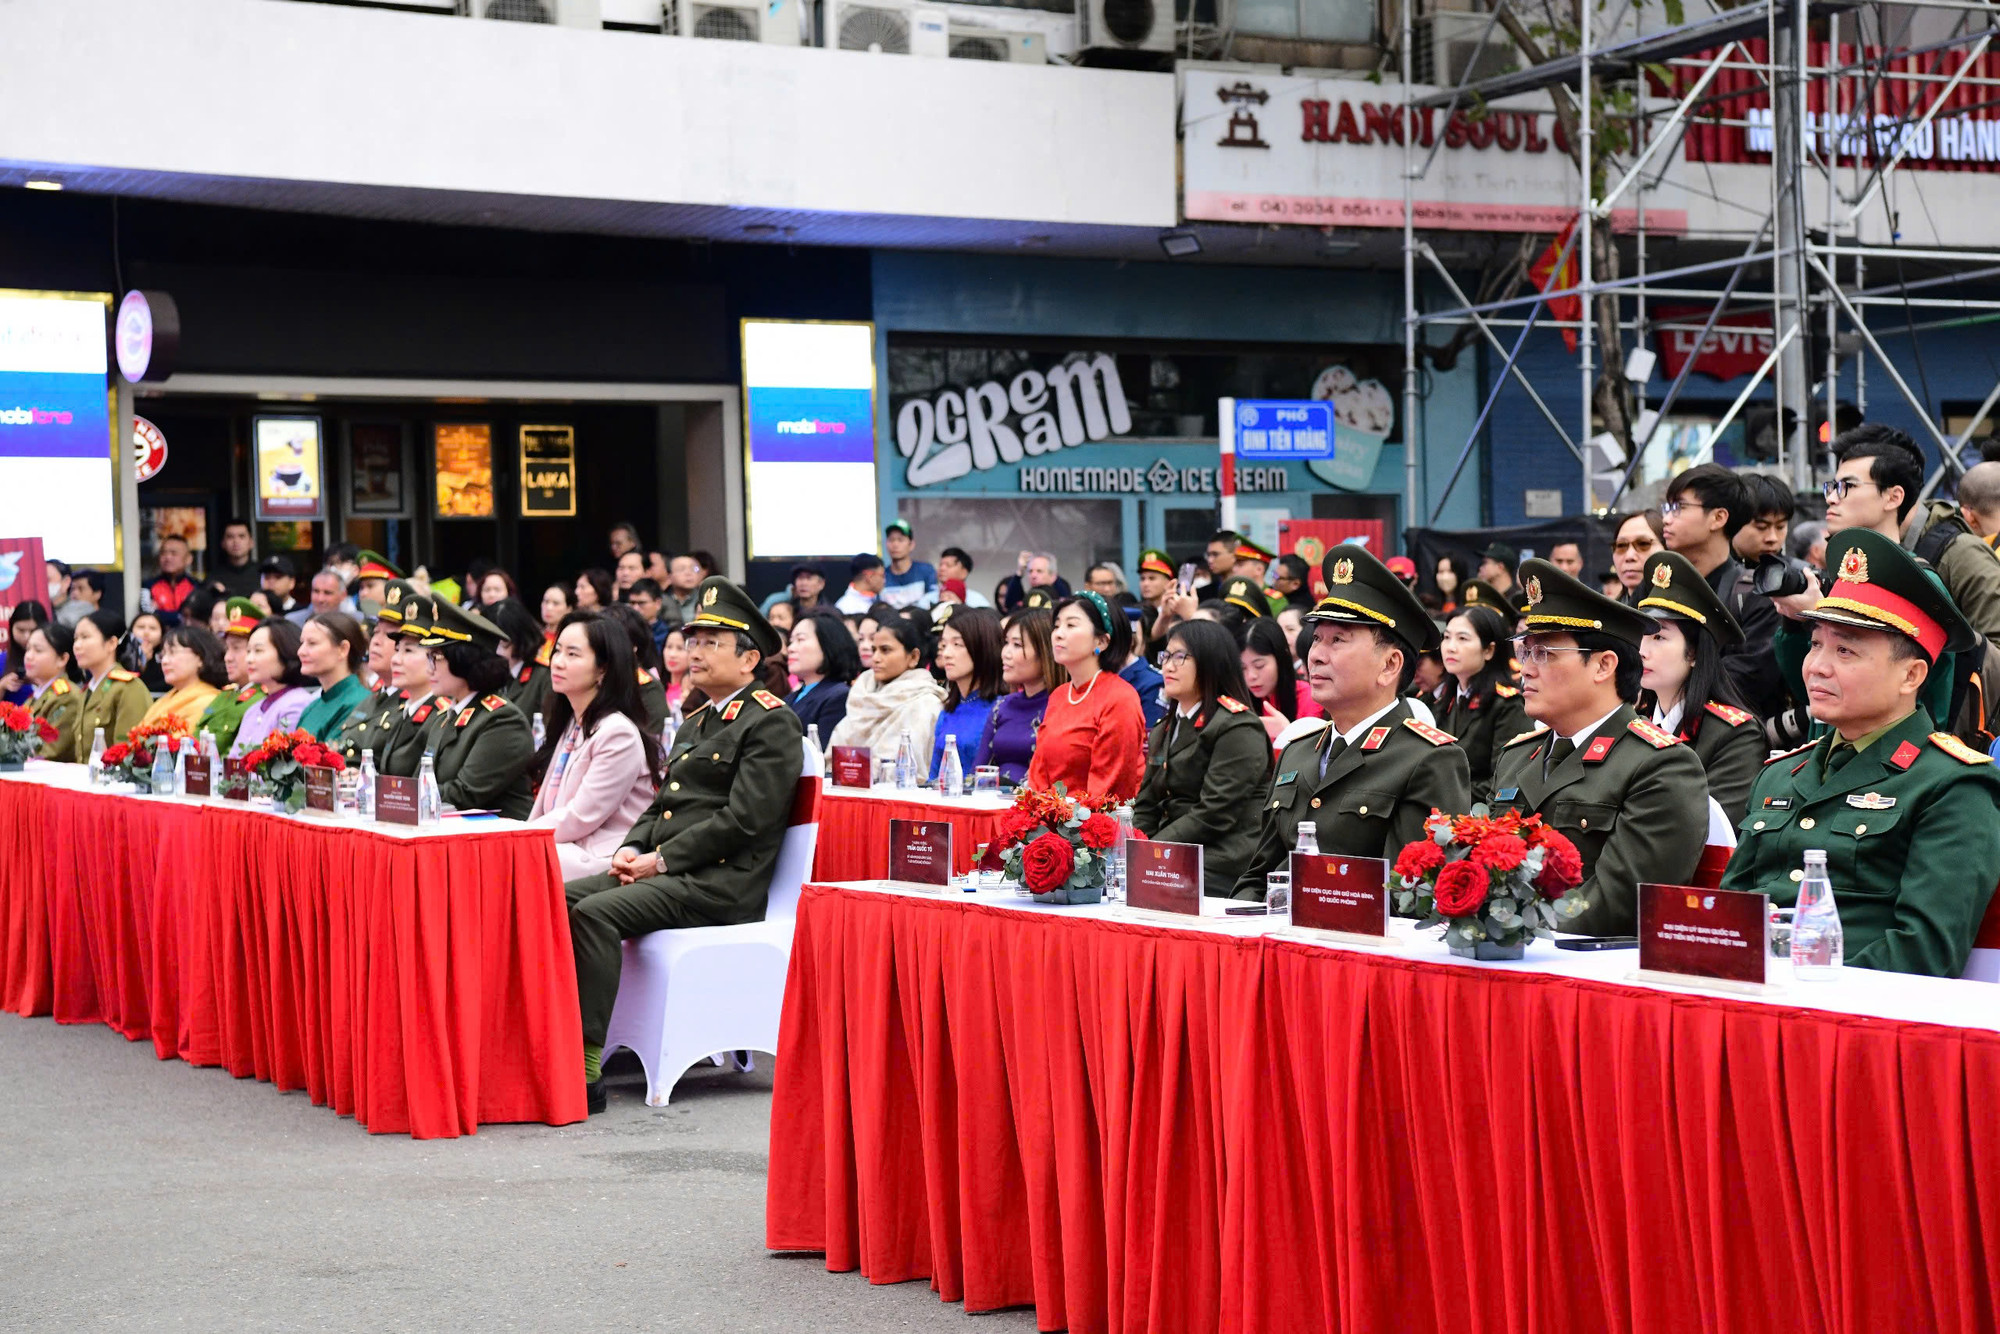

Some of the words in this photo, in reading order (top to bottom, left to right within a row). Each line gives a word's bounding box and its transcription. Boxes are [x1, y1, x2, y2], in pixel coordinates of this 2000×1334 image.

[1301, 99, 1434, 148] HANOI
[1445, 108, 1548, 154] SOUL
[777, 418, 846, 434] mobifone
[1020, 467, 1146, 492] HOMEMADE
[1181, 468, 1214, 492] ICE
